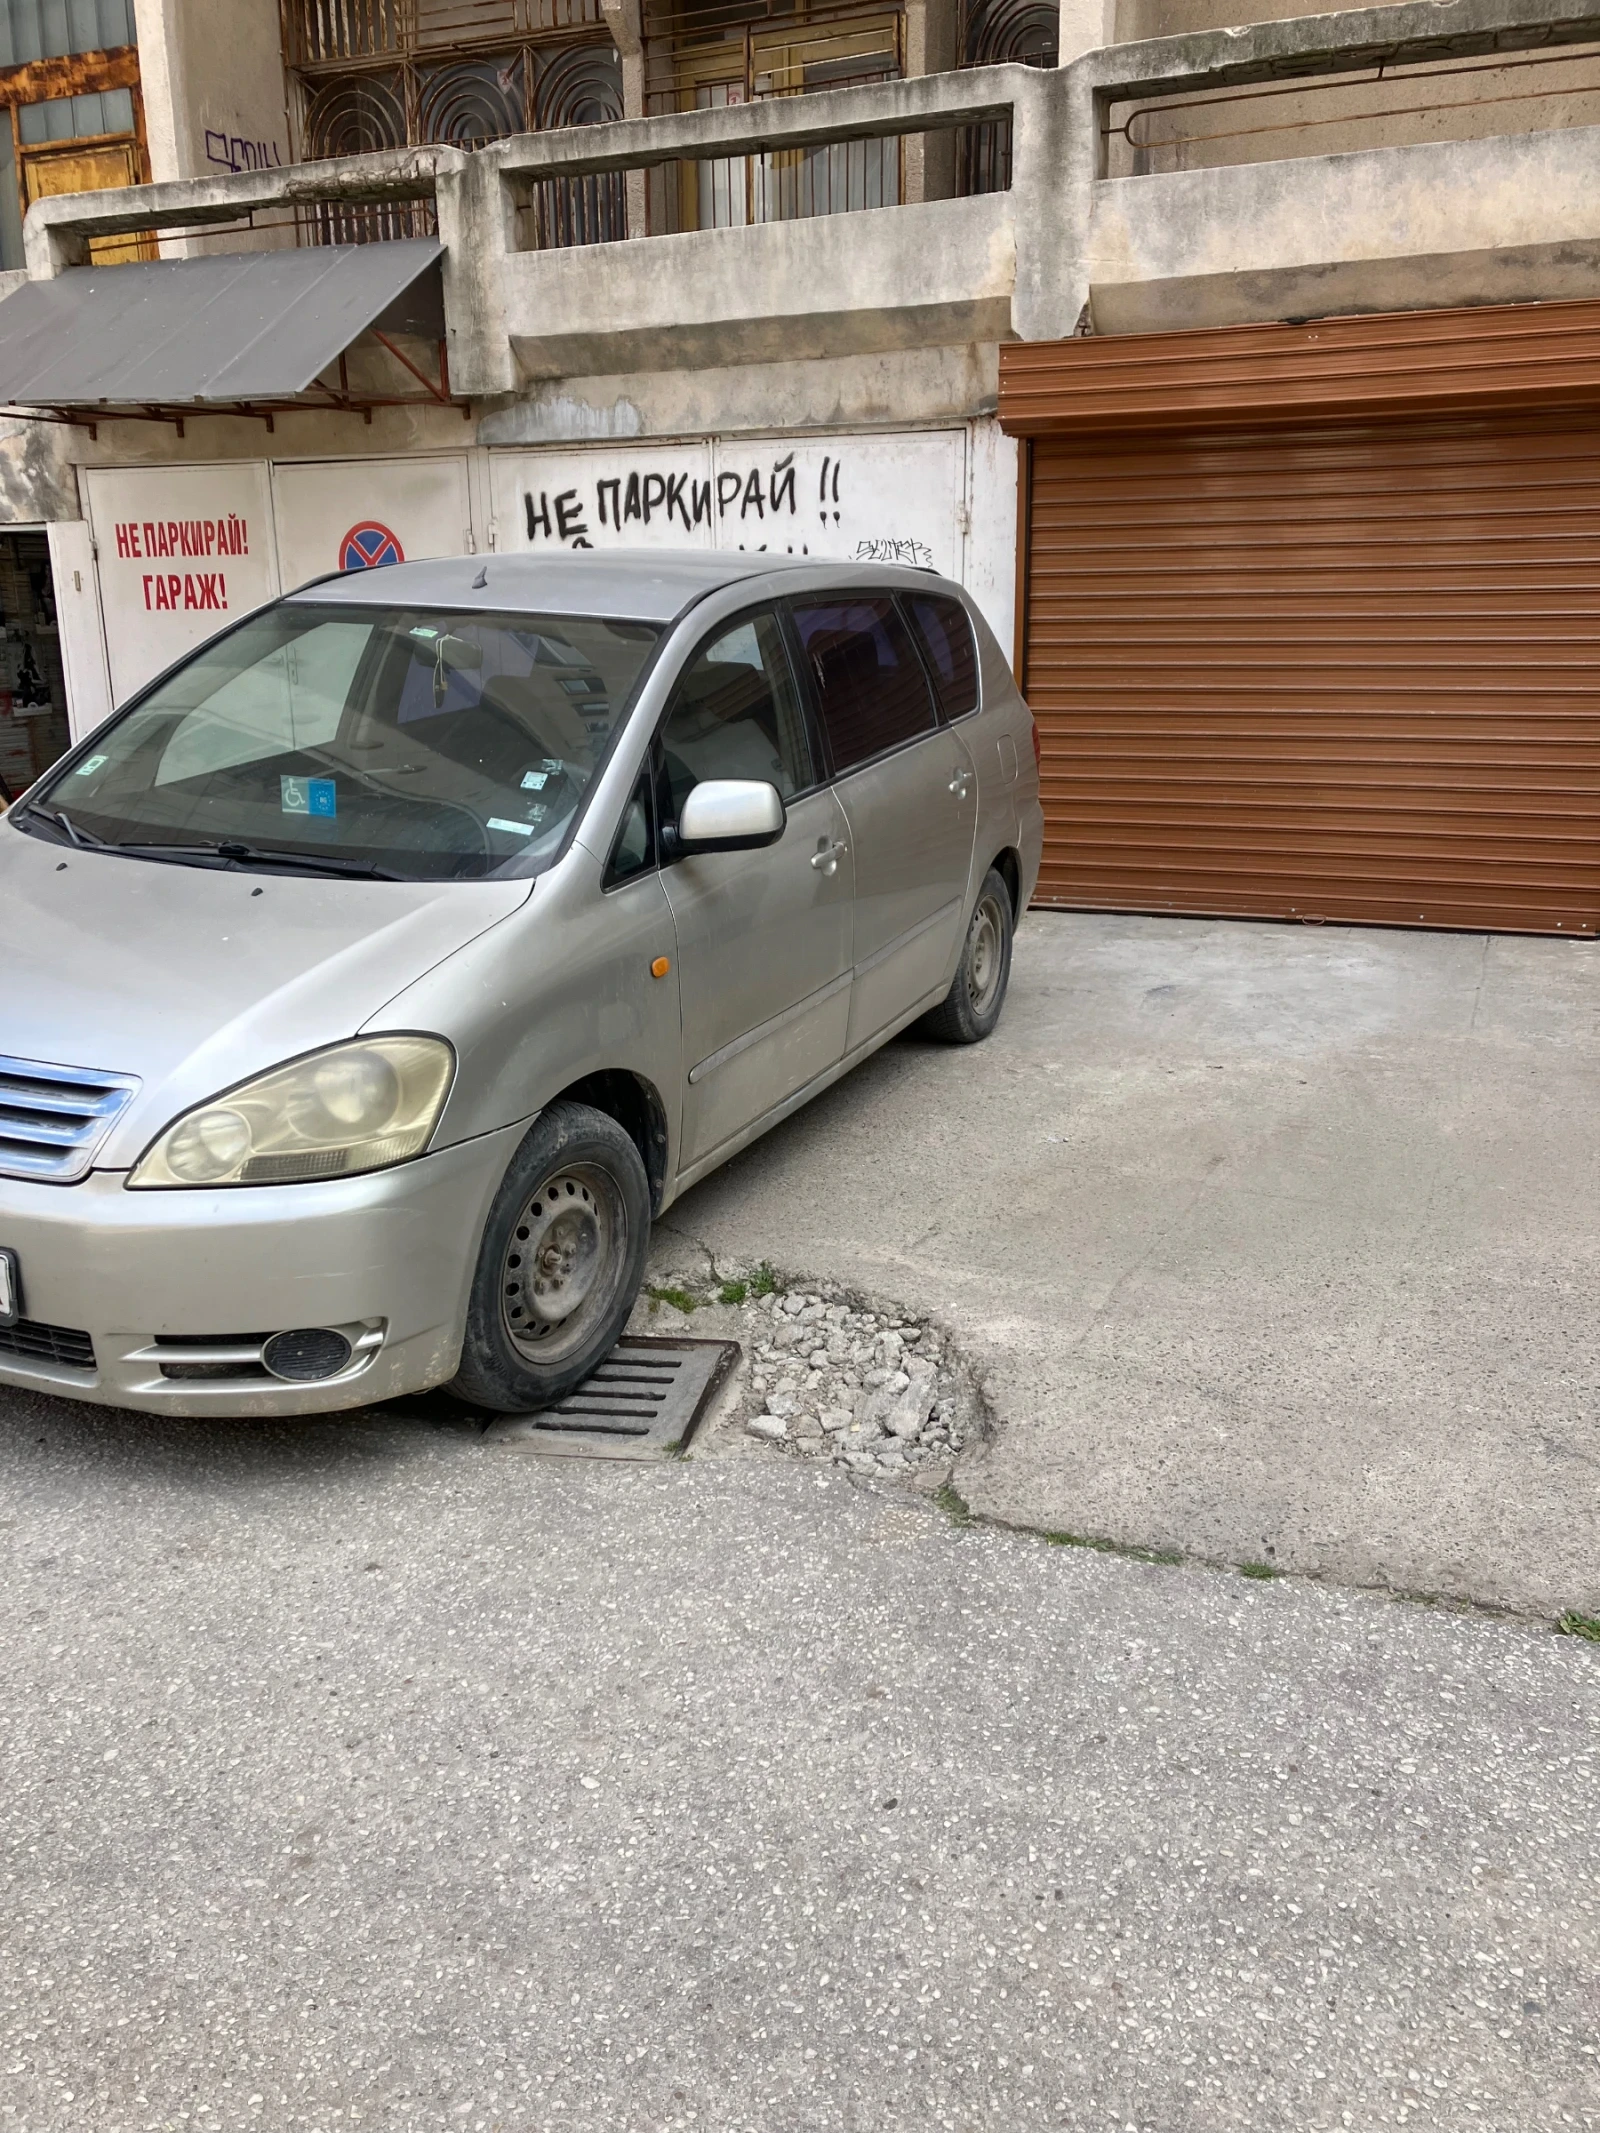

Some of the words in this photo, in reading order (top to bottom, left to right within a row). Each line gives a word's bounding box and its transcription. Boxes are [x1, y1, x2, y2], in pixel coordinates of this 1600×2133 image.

[525, 489, 588, 540] НЕ
[597, 451, 796, 532] ПАРКИРАЙ
[115, 523, 142, 558] НЕ
[143, 513, 249, 557] ПАРКИРАЙ!
[142, 573, 228, 610] ГАРАЖ!
